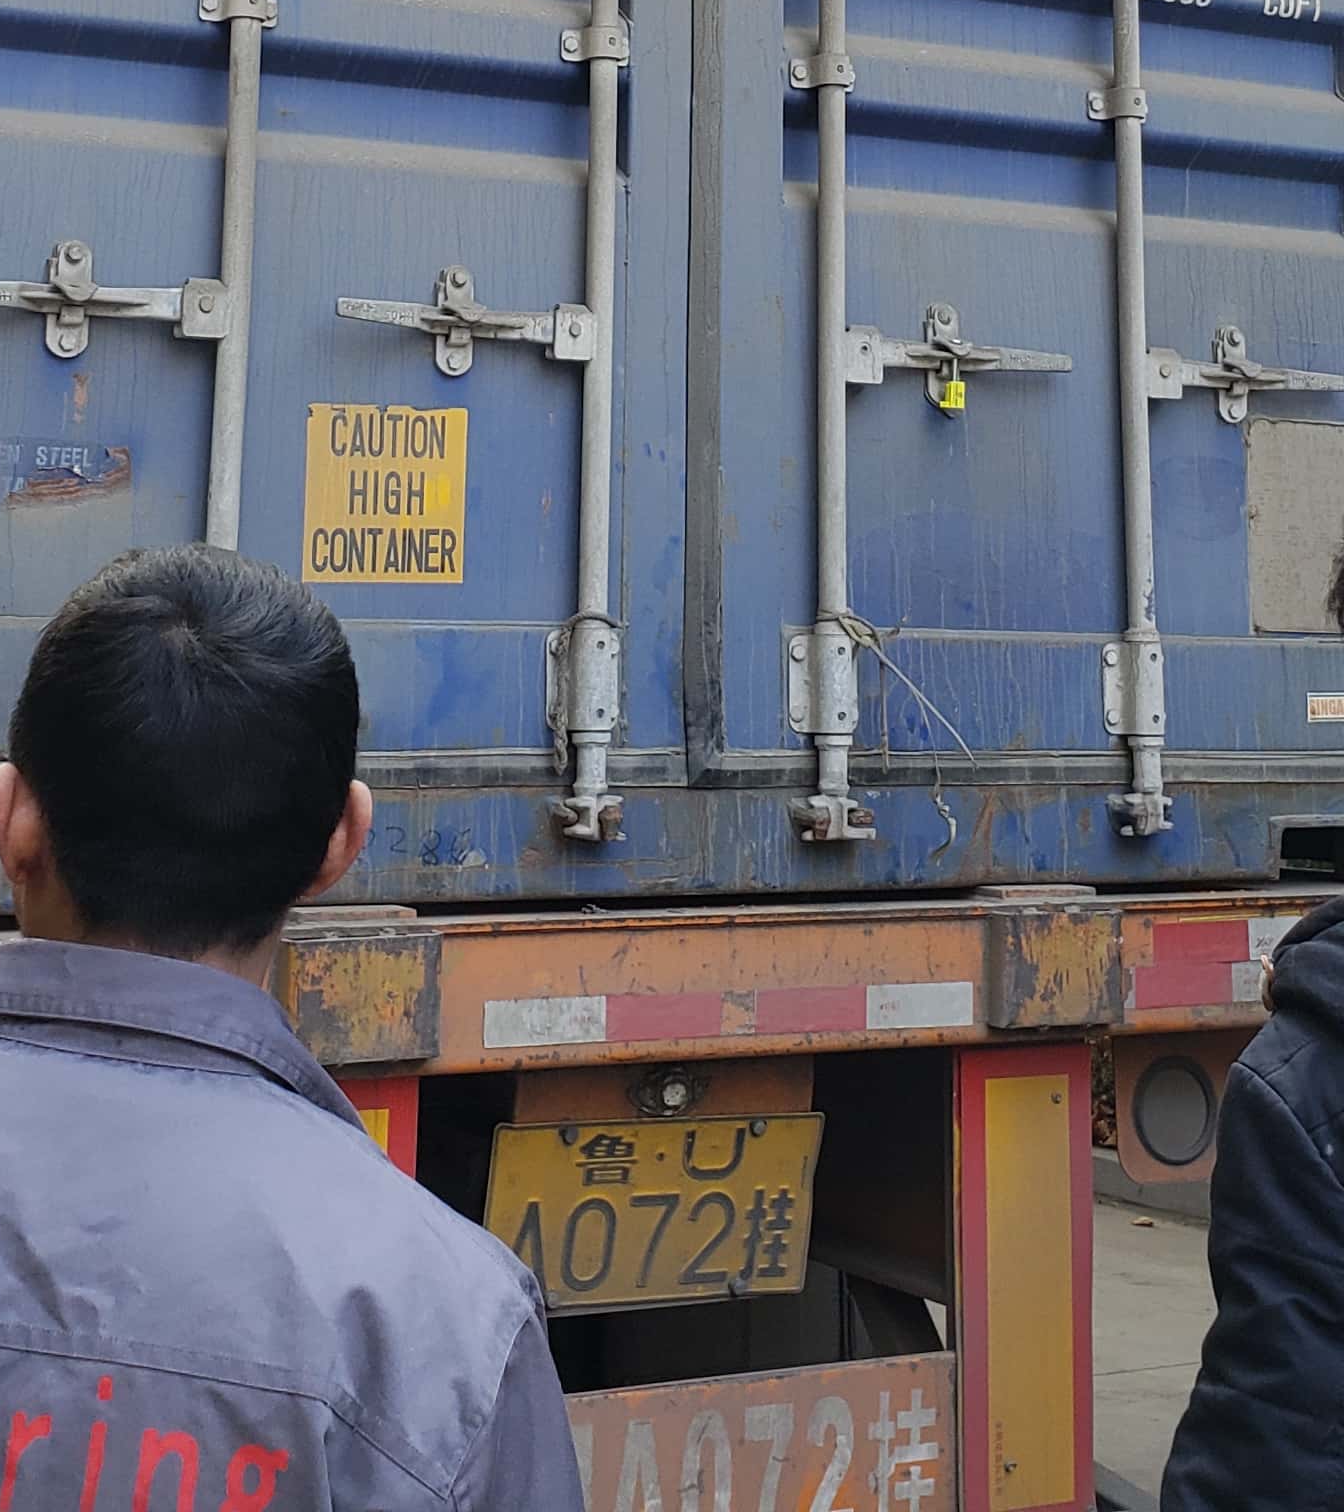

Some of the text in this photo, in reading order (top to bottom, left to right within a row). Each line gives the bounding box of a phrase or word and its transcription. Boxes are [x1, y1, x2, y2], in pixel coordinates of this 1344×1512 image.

[35, 445, 93, 467] STEEL
[330, 413, 447, 460] CAUTION
[348, 470, 426, 517] HIGH
[311, 527, 457, 575] CONTAINER
